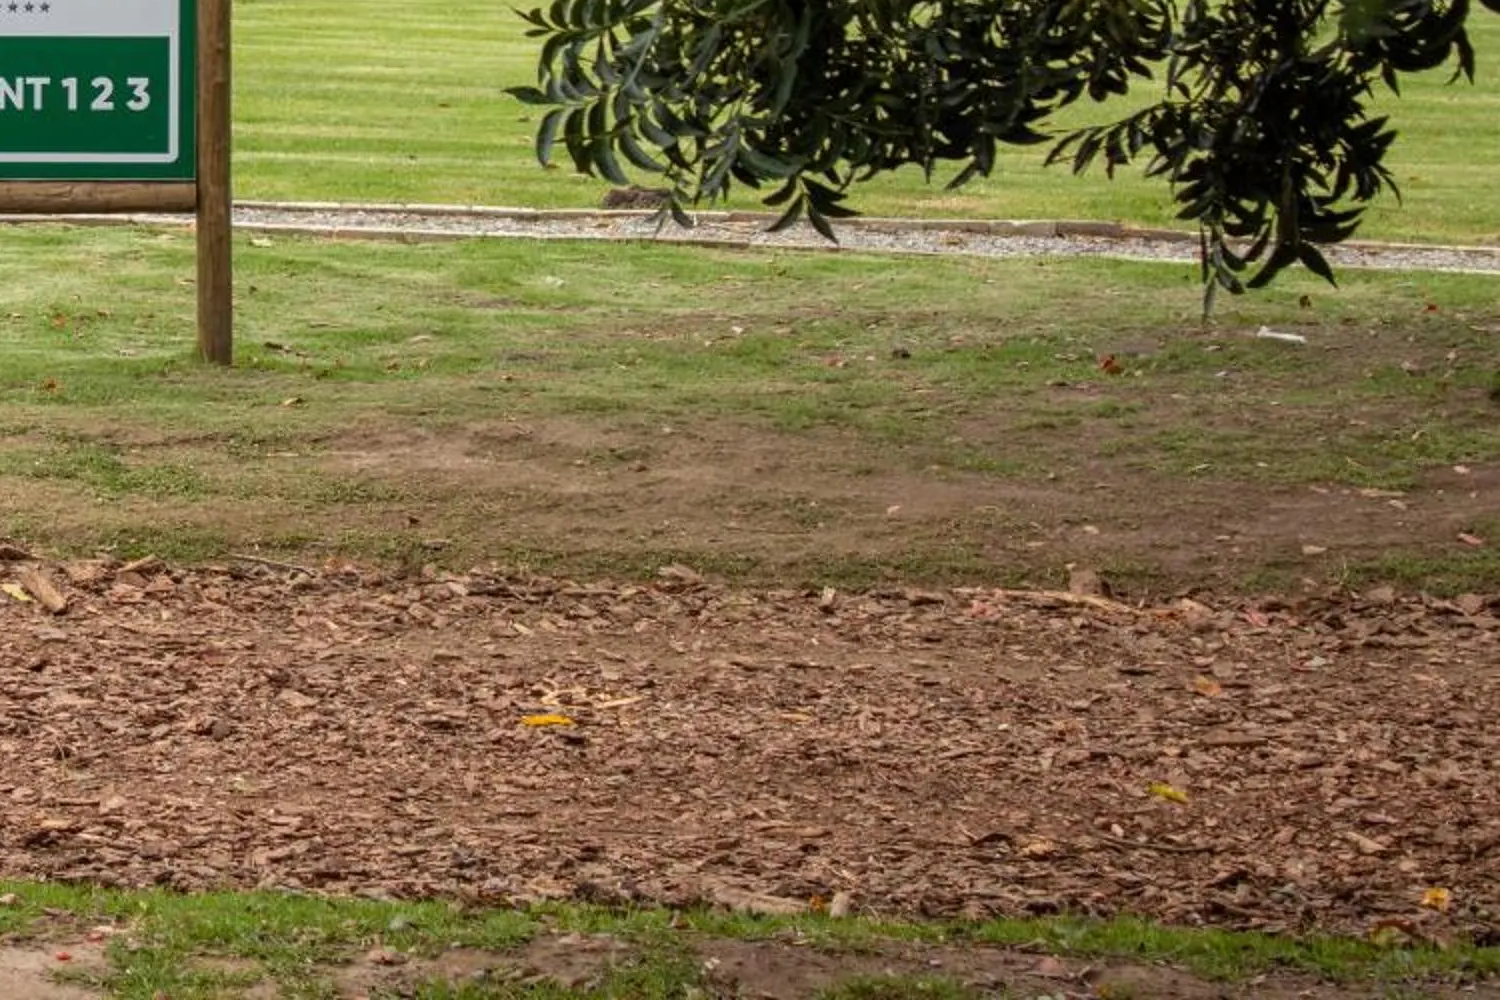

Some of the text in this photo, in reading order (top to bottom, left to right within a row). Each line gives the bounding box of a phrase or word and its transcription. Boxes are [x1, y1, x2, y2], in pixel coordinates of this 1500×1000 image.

[61, 77, 78, 110] 1
[90, 77, 115, 110] 2
[126, 77, 151, 111] 3
